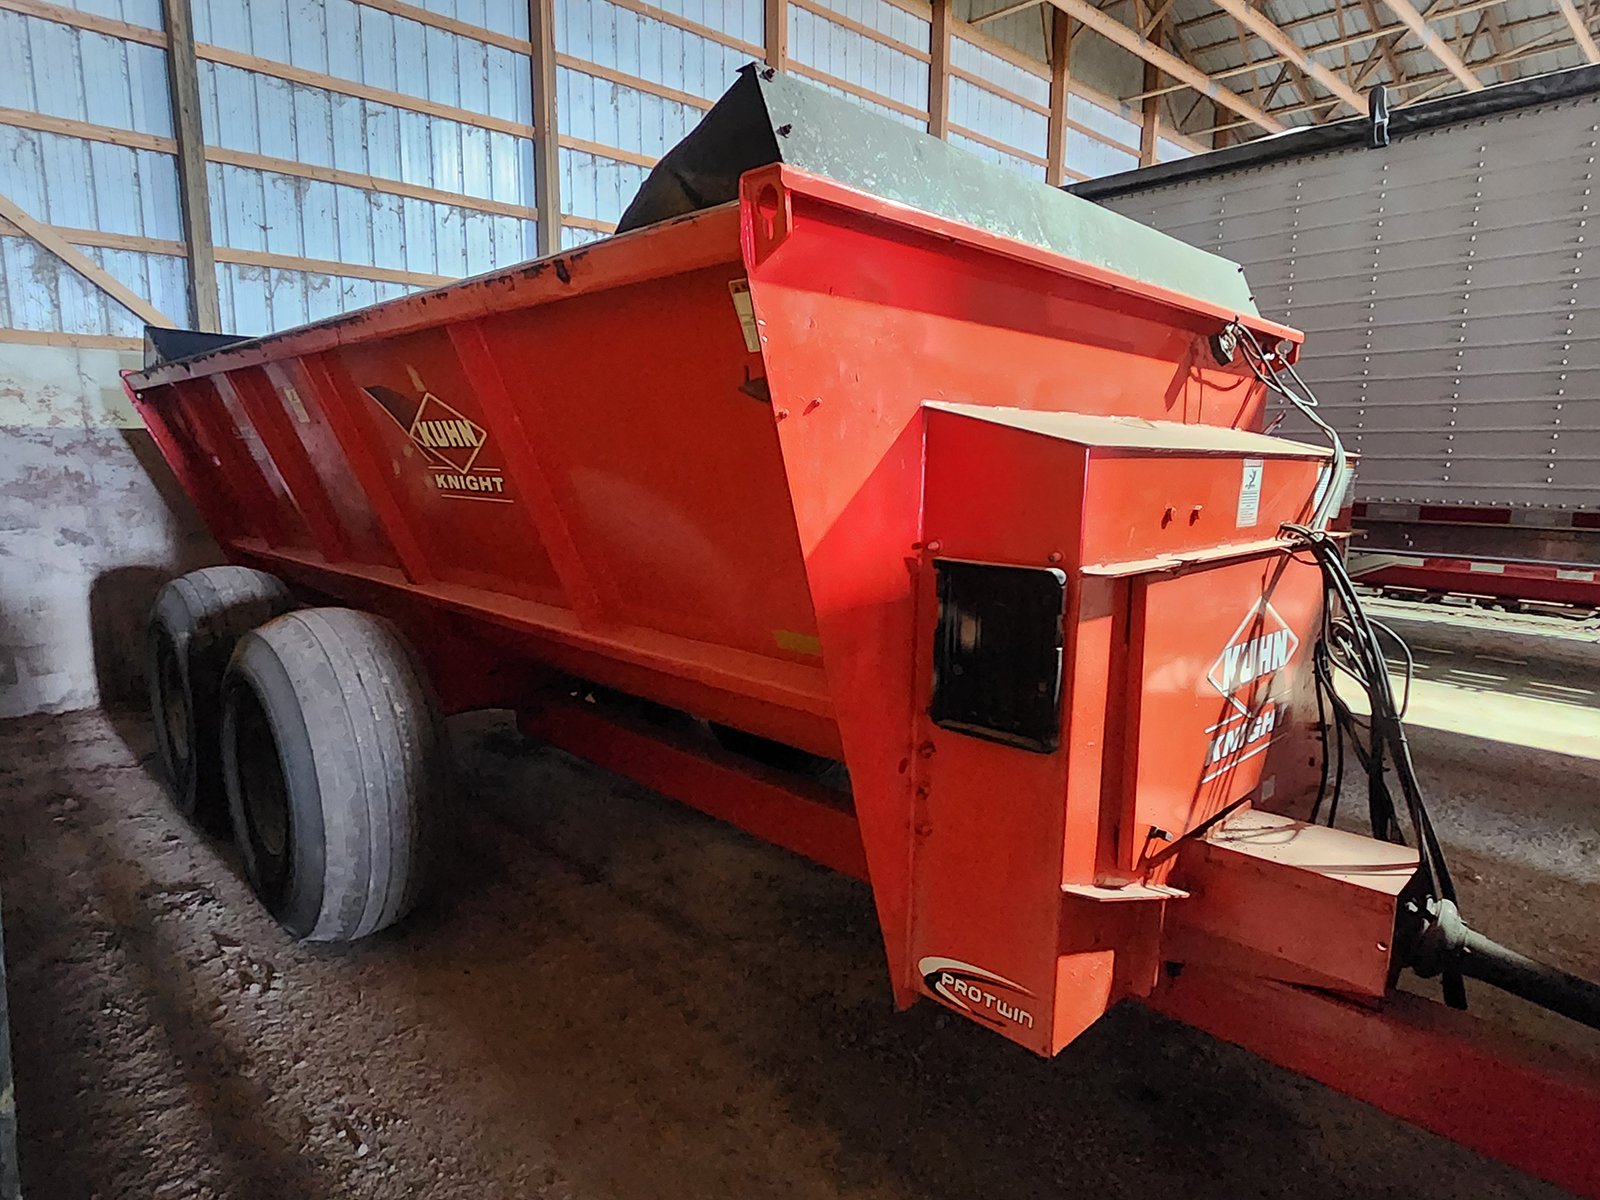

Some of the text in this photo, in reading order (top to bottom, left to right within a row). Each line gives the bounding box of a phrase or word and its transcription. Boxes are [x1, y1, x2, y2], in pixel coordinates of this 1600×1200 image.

[417, 420, 479, 447] KUHN
[435, 474, 503, 492] KNIGHT
[1222, 628, 1288, 690] KUHN
